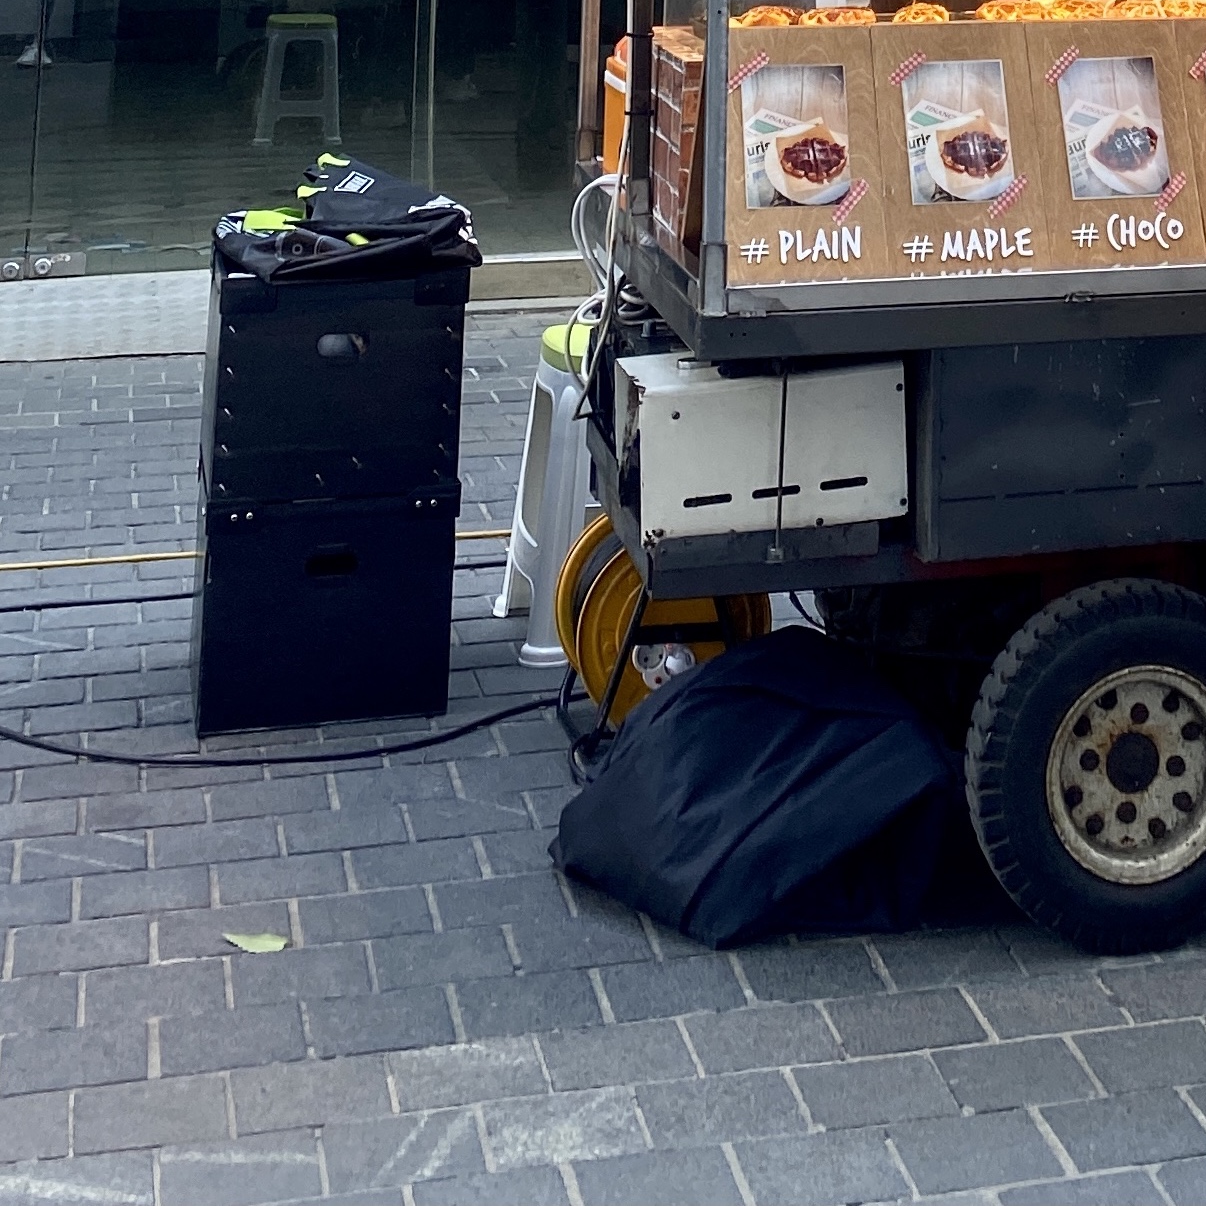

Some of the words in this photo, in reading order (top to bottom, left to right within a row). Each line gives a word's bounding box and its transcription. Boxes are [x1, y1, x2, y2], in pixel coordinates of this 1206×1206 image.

[778, 226, 861, 264] PLAIN
[941, 227, 1034, 261] MAPLE
[1107, 212, 1184, 251] CHOCO
